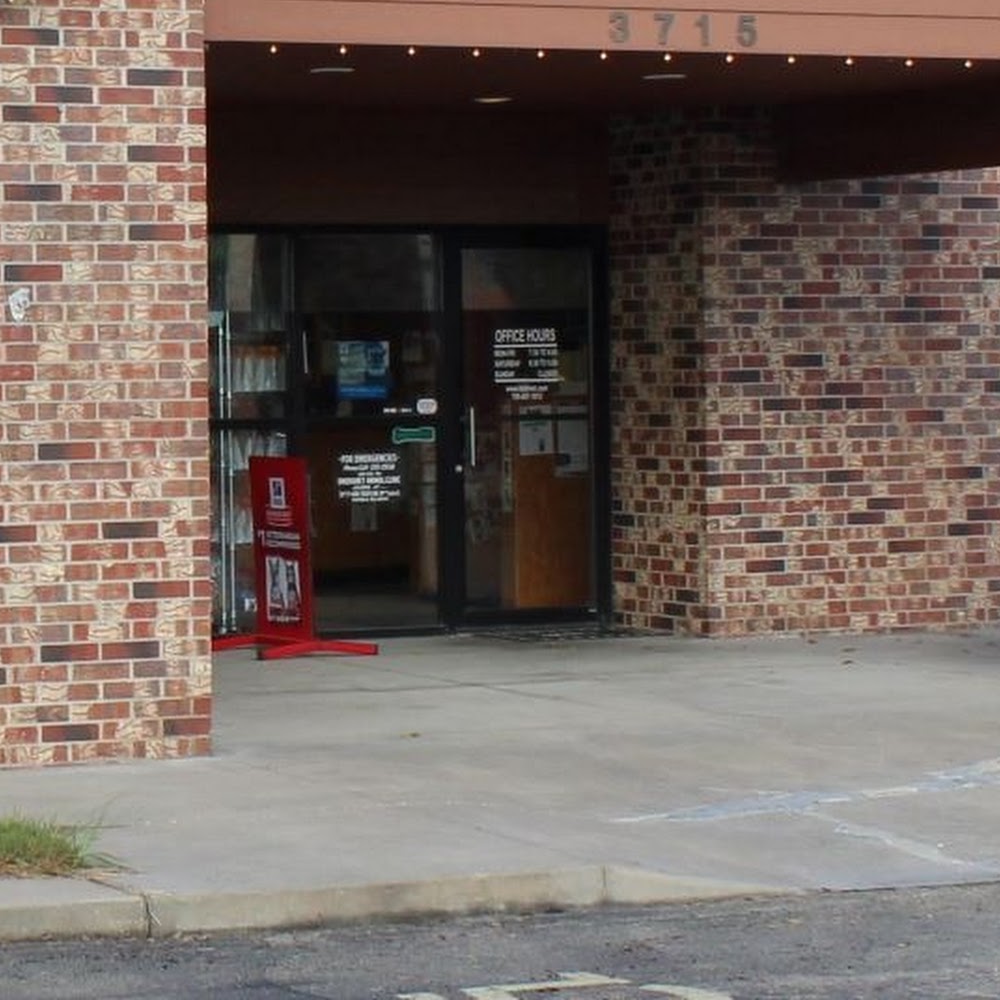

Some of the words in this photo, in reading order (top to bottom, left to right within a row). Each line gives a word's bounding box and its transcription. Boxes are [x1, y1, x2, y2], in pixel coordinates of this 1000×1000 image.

[608, 12, 757, 47] 3715
[494, 329, 525, 343] OFFICE
[526, 328, 556, 342] HOURS
